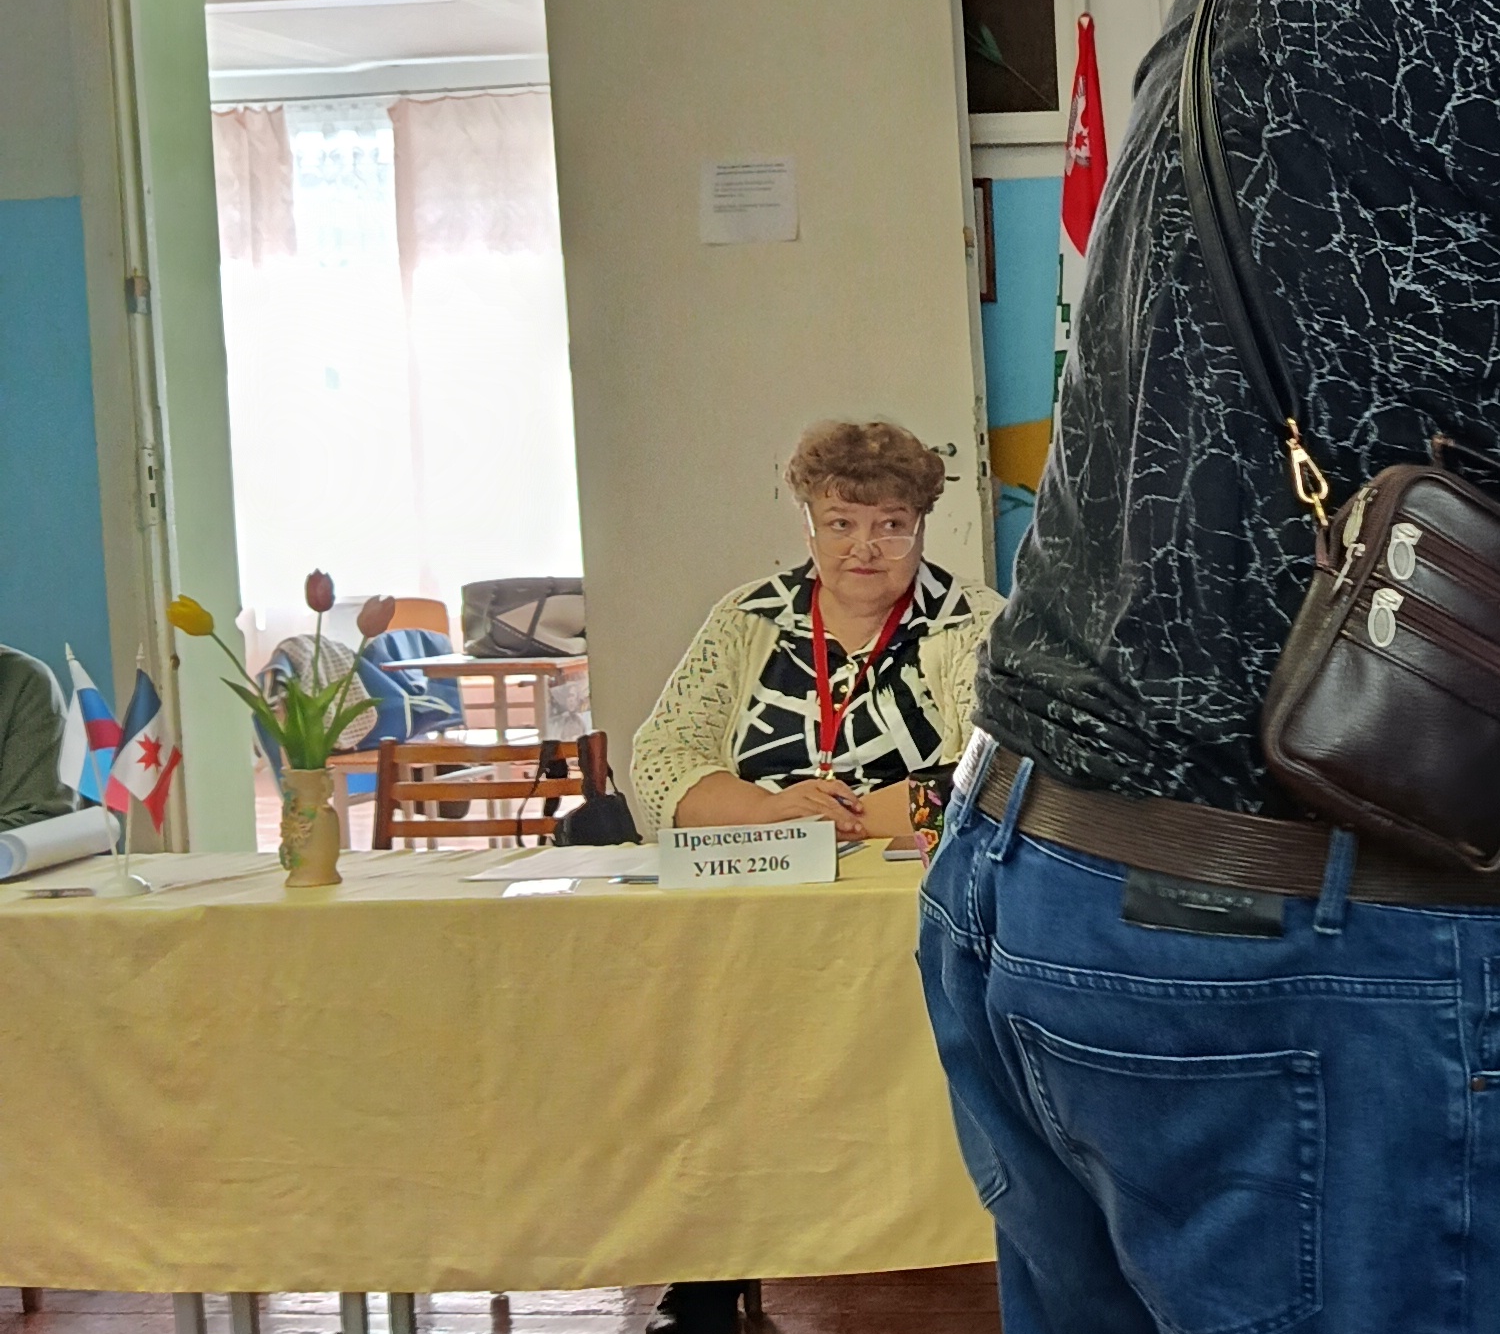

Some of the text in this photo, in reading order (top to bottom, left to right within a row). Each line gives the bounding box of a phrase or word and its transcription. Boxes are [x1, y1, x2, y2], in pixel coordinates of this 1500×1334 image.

[674, 828, 807, 851] Председатель
[694, 855, 790, 877] УИК 2206
